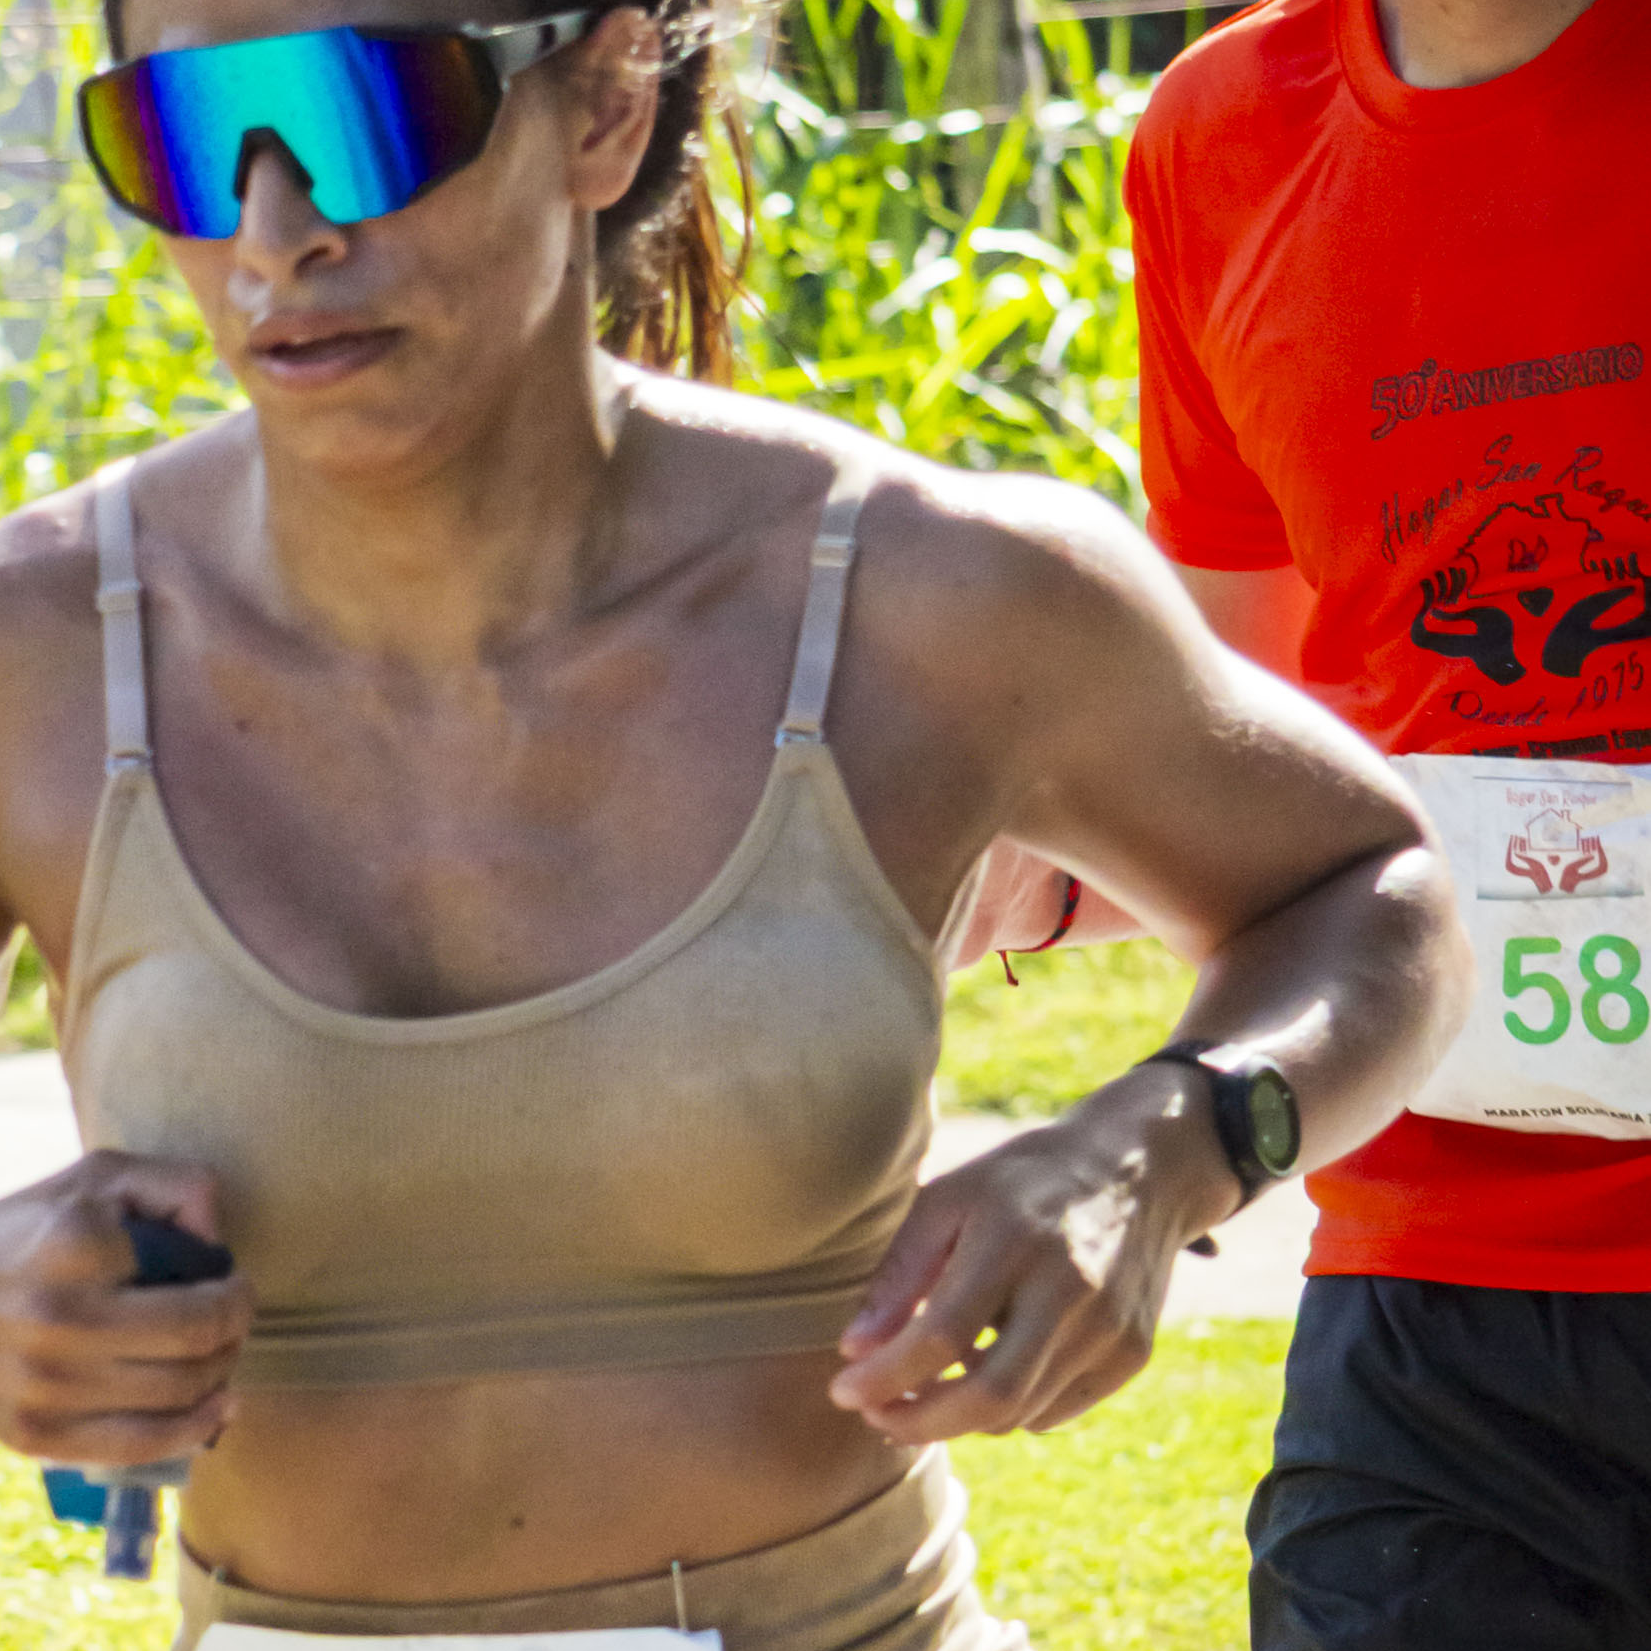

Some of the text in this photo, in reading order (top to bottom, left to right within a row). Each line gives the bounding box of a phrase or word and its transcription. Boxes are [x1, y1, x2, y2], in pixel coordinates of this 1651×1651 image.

[1431, 342, 1645, 416] ANIVERSARIO
[1475, 433, 1543, 491] San
[1502, 933, 1650, 1045] 58
[1483, 1106, 1564, 1119] MARATON
